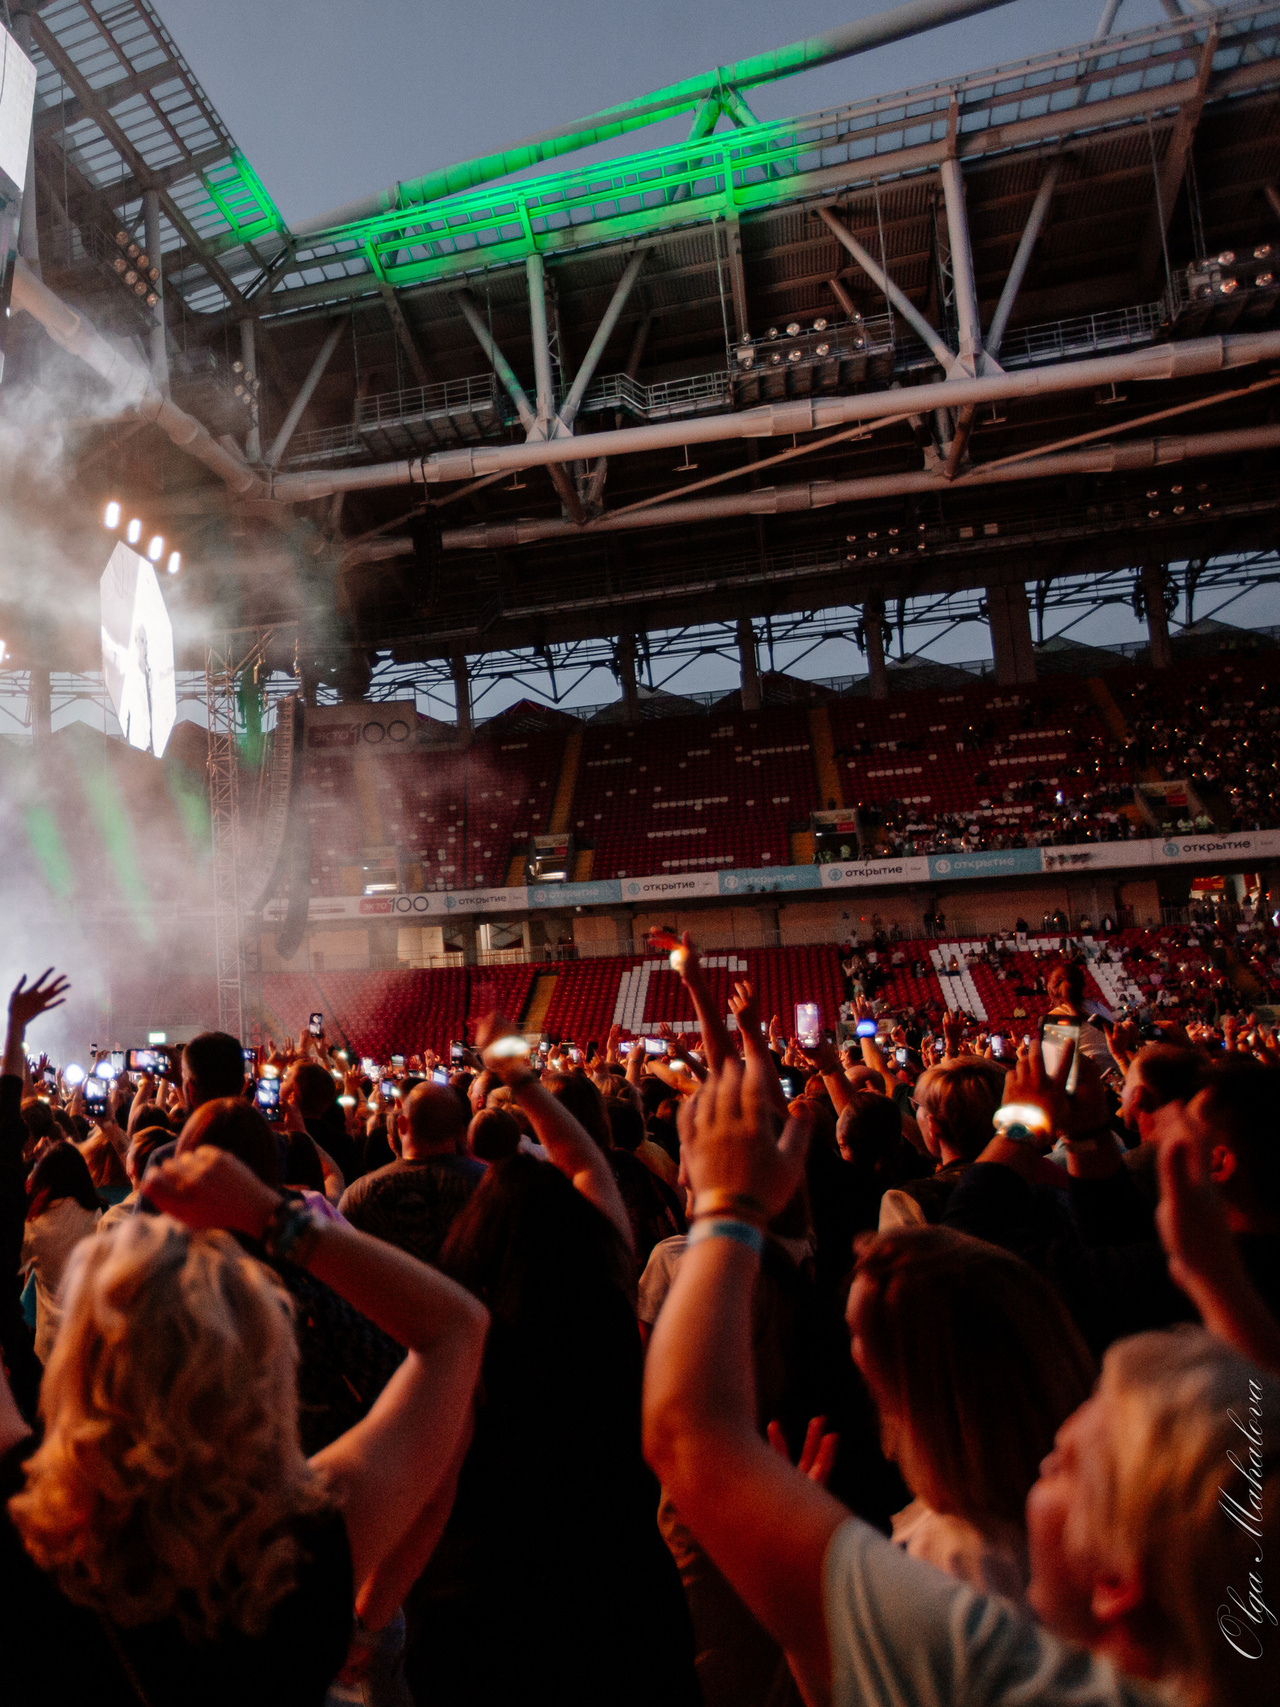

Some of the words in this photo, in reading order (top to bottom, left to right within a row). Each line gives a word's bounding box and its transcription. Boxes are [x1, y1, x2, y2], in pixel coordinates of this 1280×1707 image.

[1182, 840, 1251, 856] открытие
[953, 857, 1015, 872] открытие
[845, 866, 903, 879] открытие
[642, 880, 695, 893] открытие
[458, 894, 507, 907] открытие
